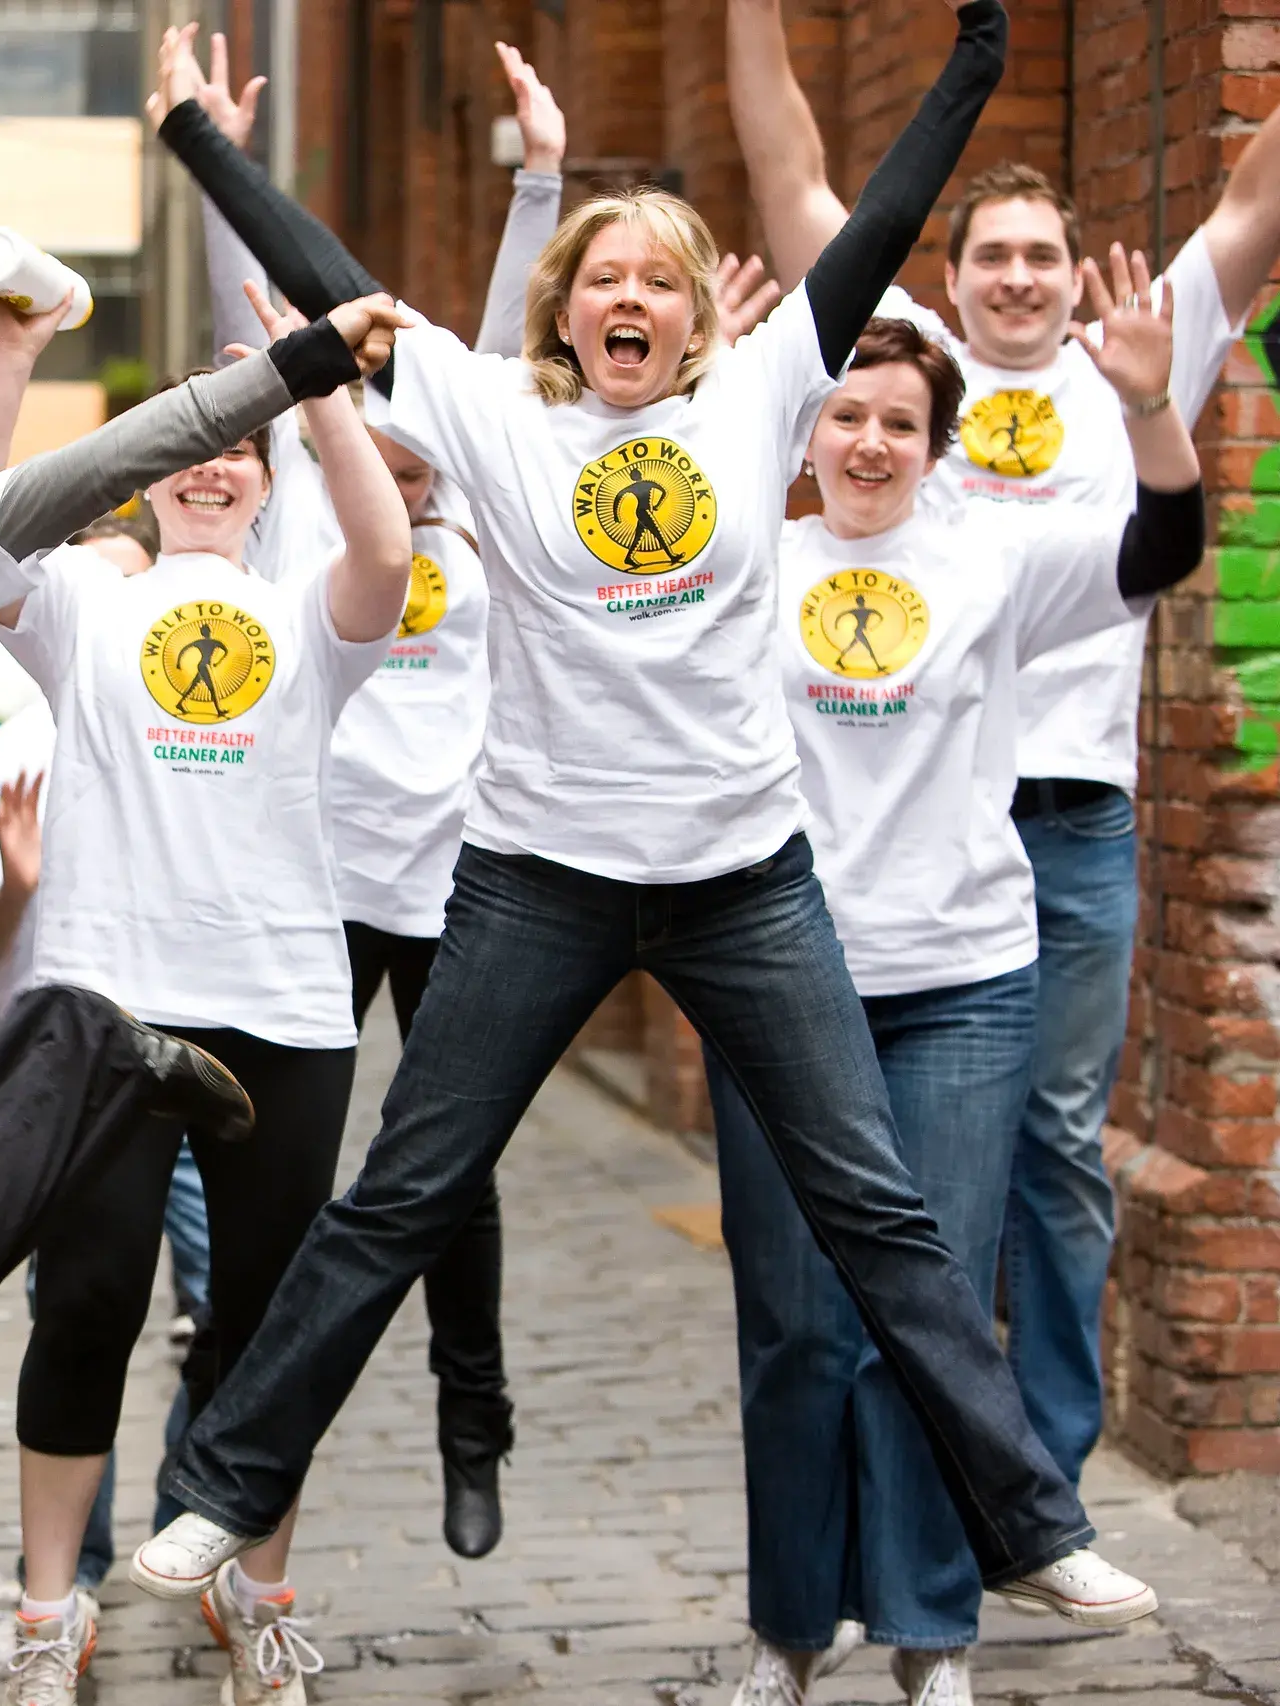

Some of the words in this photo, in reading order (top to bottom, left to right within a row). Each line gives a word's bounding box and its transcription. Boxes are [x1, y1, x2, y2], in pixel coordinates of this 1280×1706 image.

[576, 461, 614, 518] WALK
[618, 442, 649, 463] TO
[659, 442, 712, 501] WORK
[597, 582, 653, 601] BETTER
[657, 571, 714, 594] HEALTH
[852, 572, 878, 587] TO
[679, 588, 706, 605] AIR
[144, 608, 187, 658] WALK
[196, 603, 224, 616] TO
[233, 610, 271, 666] WORK
[807, 684, 855, 700] BETTER
[859, 683, 915, 701] HEALTH
[816, 700, 878, 717] CLEANER
[882, 700, 907, 715] AIR
[147, 727, 196, 742] BETTER
[199, 731, 255, 748] HEALTH
[154, 745, 217, 763] CLEANER
[220, 750, 245, 764] AIR
